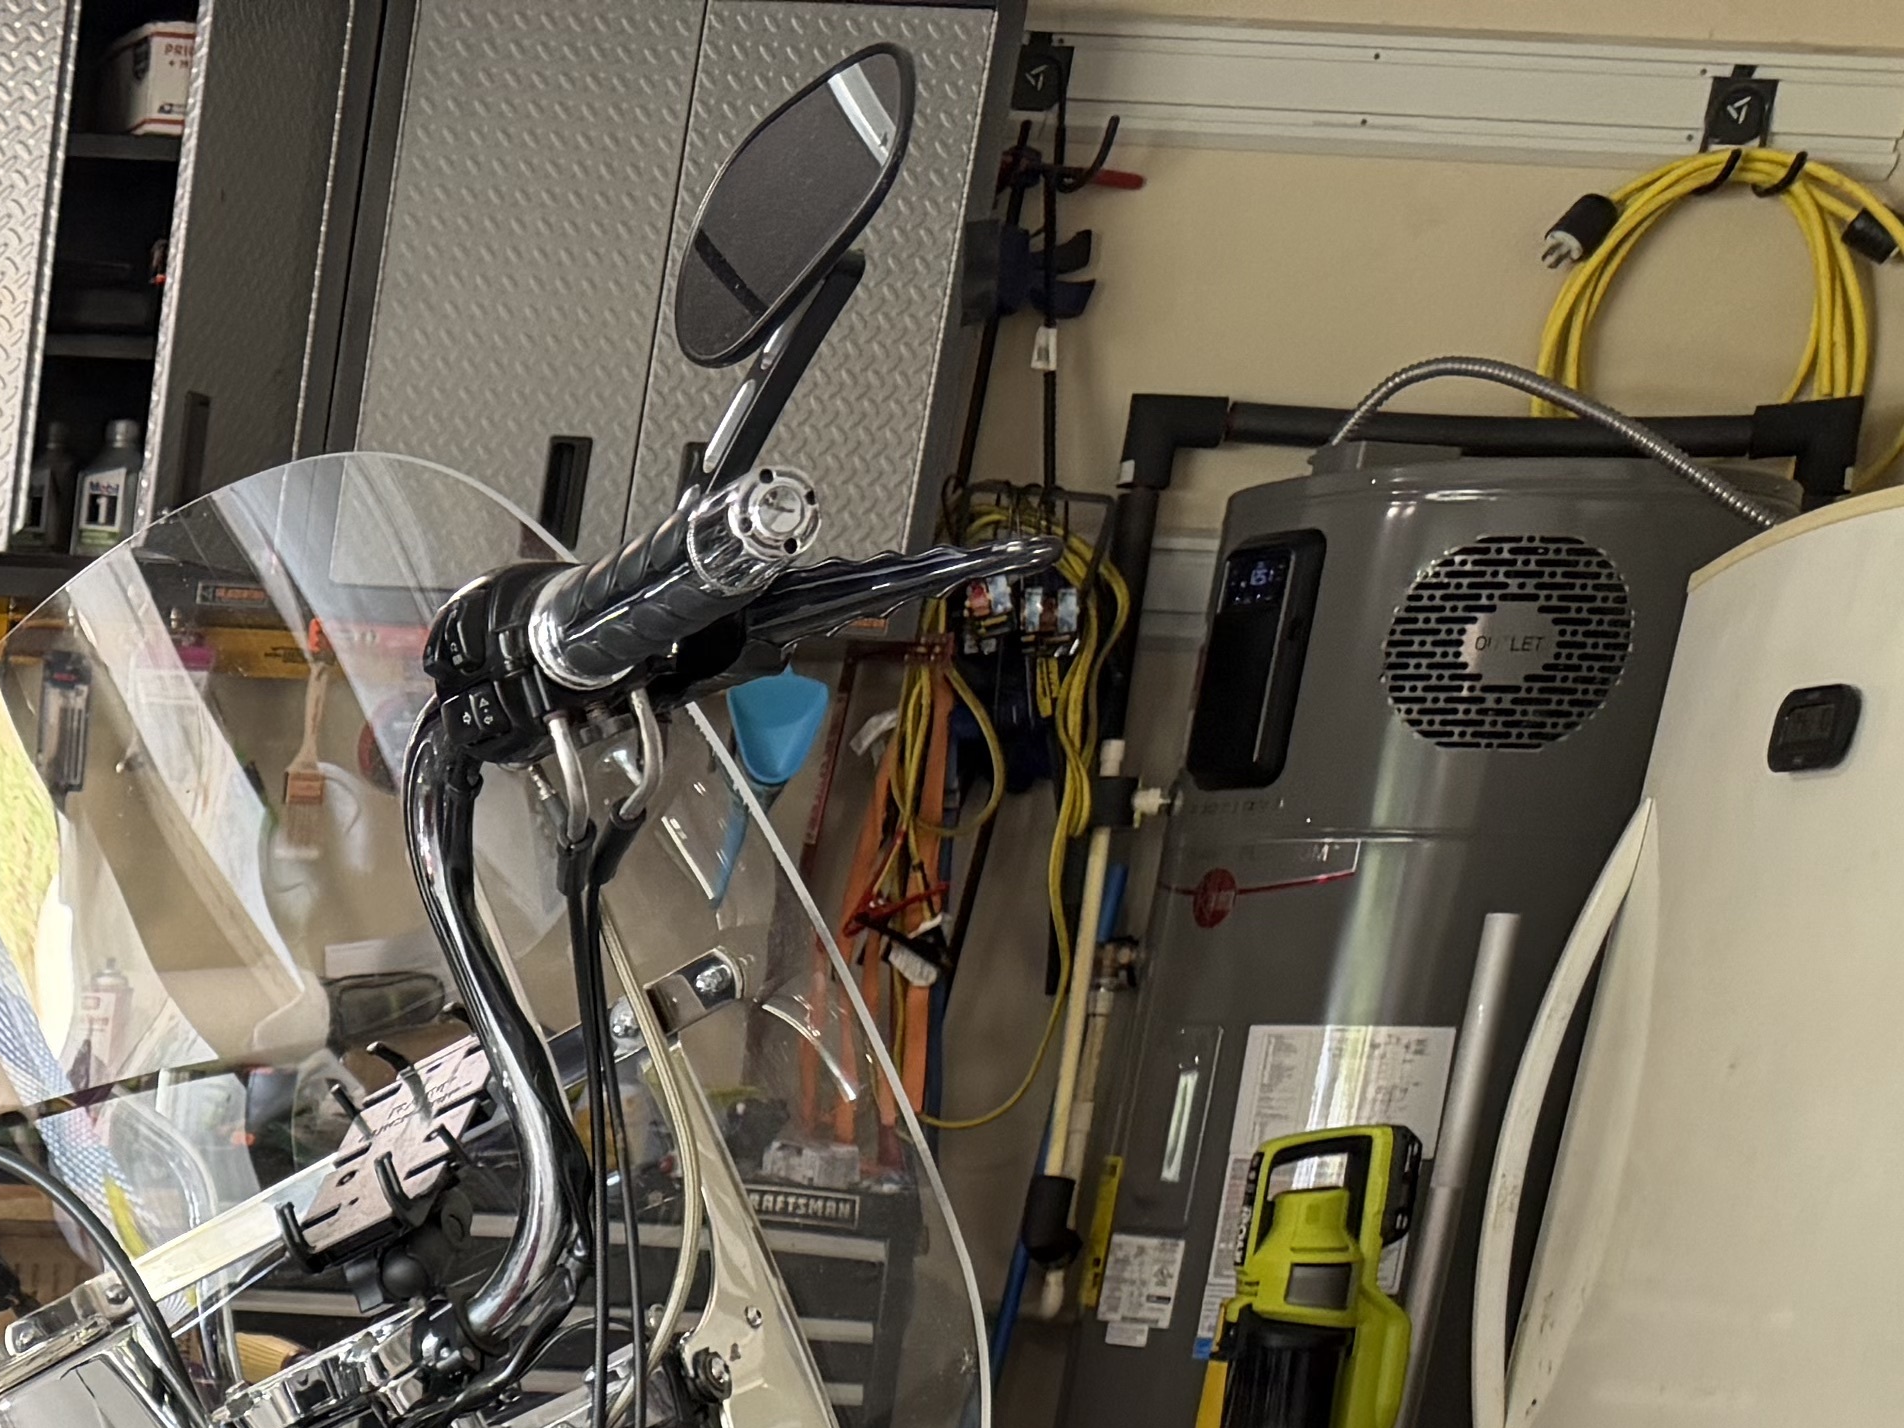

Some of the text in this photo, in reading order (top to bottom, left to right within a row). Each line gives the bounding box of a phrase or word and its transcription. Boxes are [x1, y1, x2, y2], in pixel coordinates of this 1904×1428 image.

[96, 495, 109, 525] 1
[1474, 635, 1544, 652] OLET
[748, 1191, 852, 1219] RAFTSMAN
